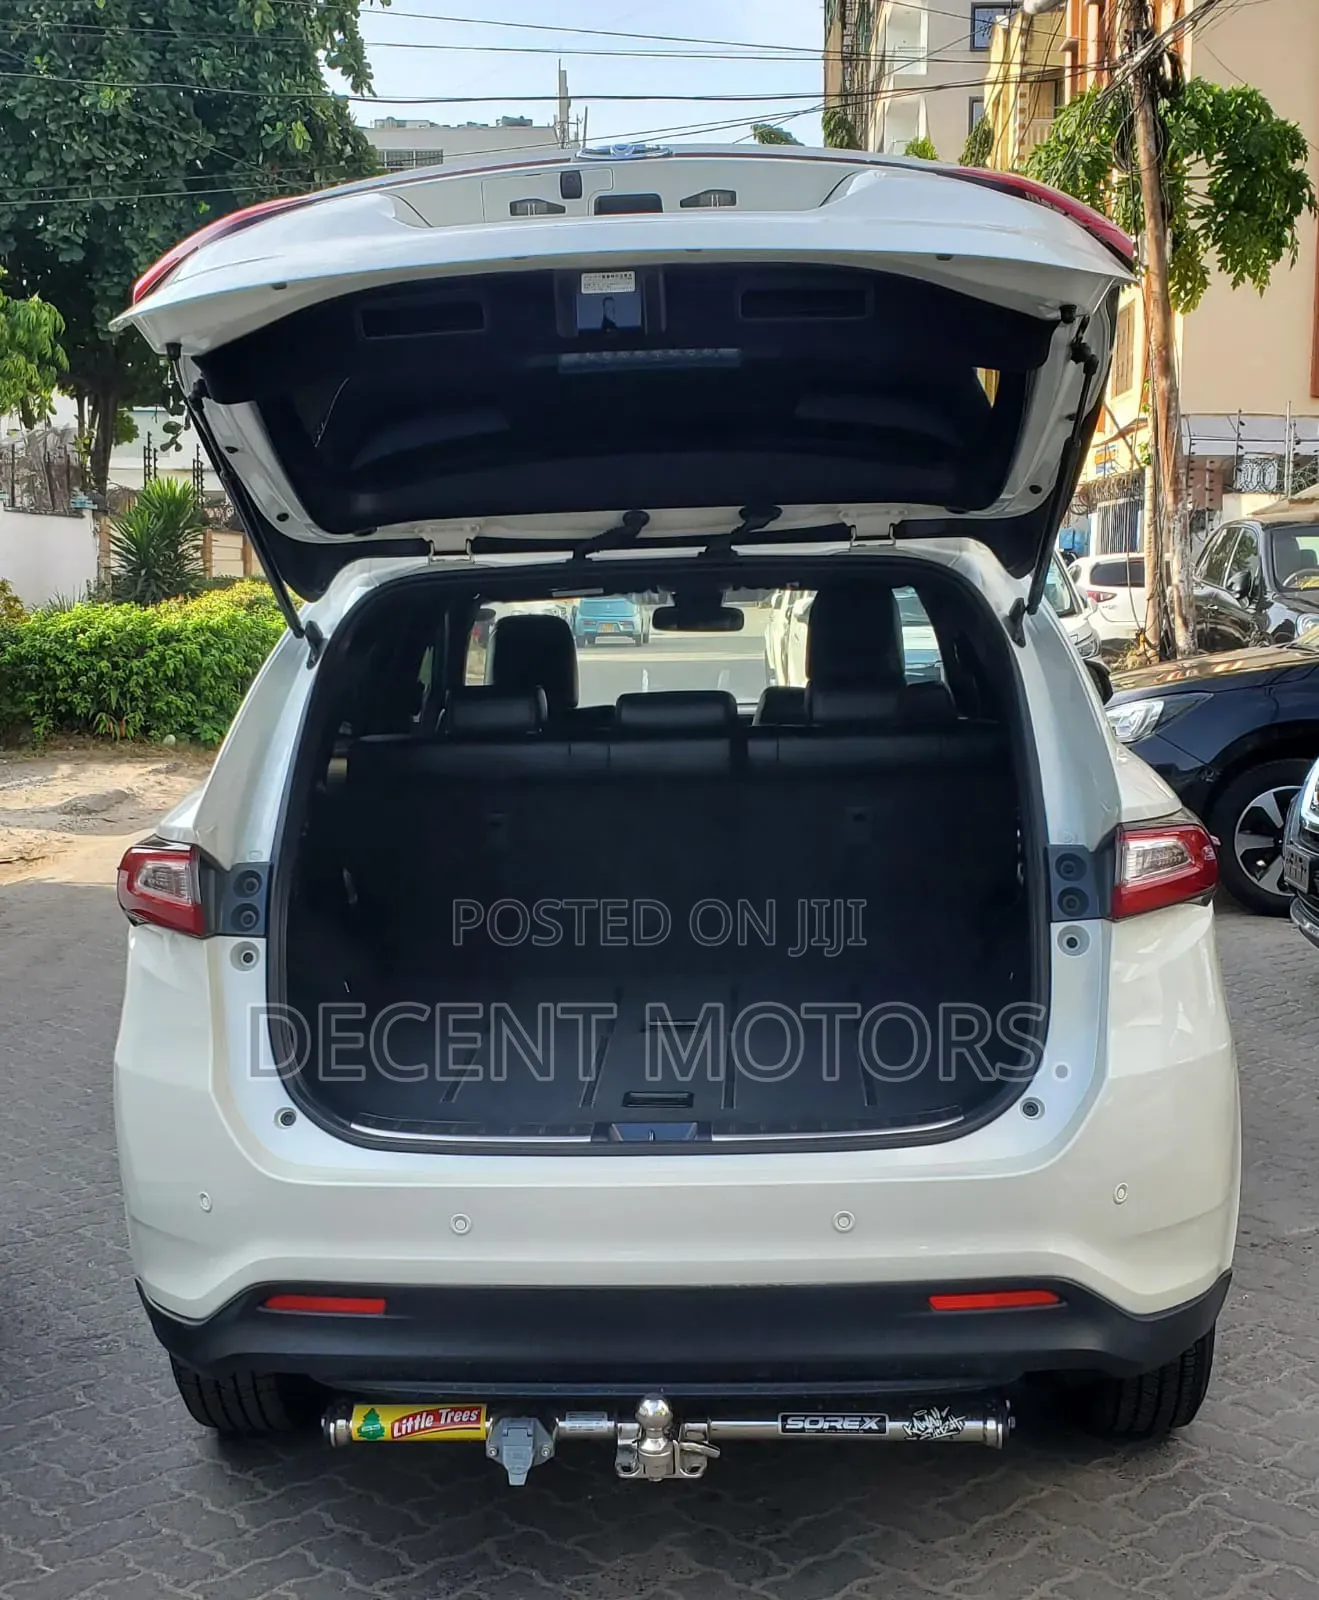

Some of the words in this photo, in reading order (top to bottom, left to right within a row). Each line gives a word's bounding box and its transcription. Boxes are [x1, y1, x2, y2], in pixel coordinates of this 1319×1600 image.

[393, 1413, 433, 1437] Little
[439, 1408, 479, 1424] Trees
[785, 1416, 882, 1430] SOREX
